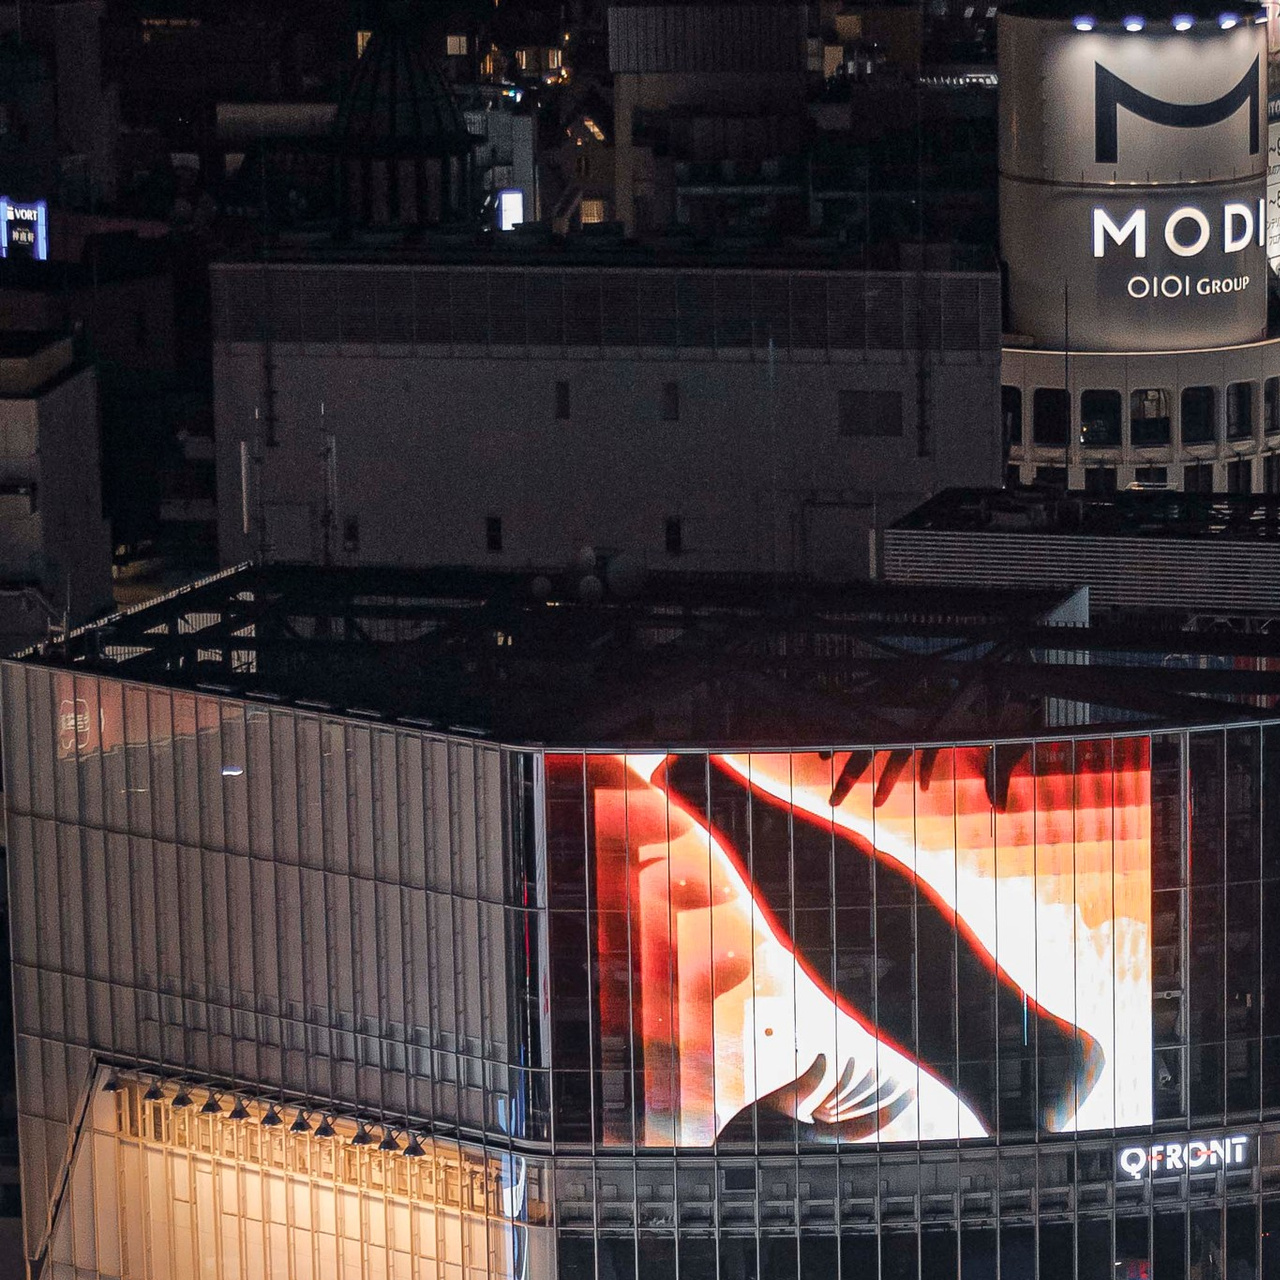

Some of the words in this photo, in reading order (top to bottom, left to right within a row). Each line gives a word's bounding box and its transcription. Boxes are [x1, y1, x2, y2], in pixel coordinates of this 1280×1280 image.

[1093, 198, 1265, 258] MODI
[1196, 276, 1250, 295] GROUP
[1120, 1136, 1247, 1180] QFRONT
